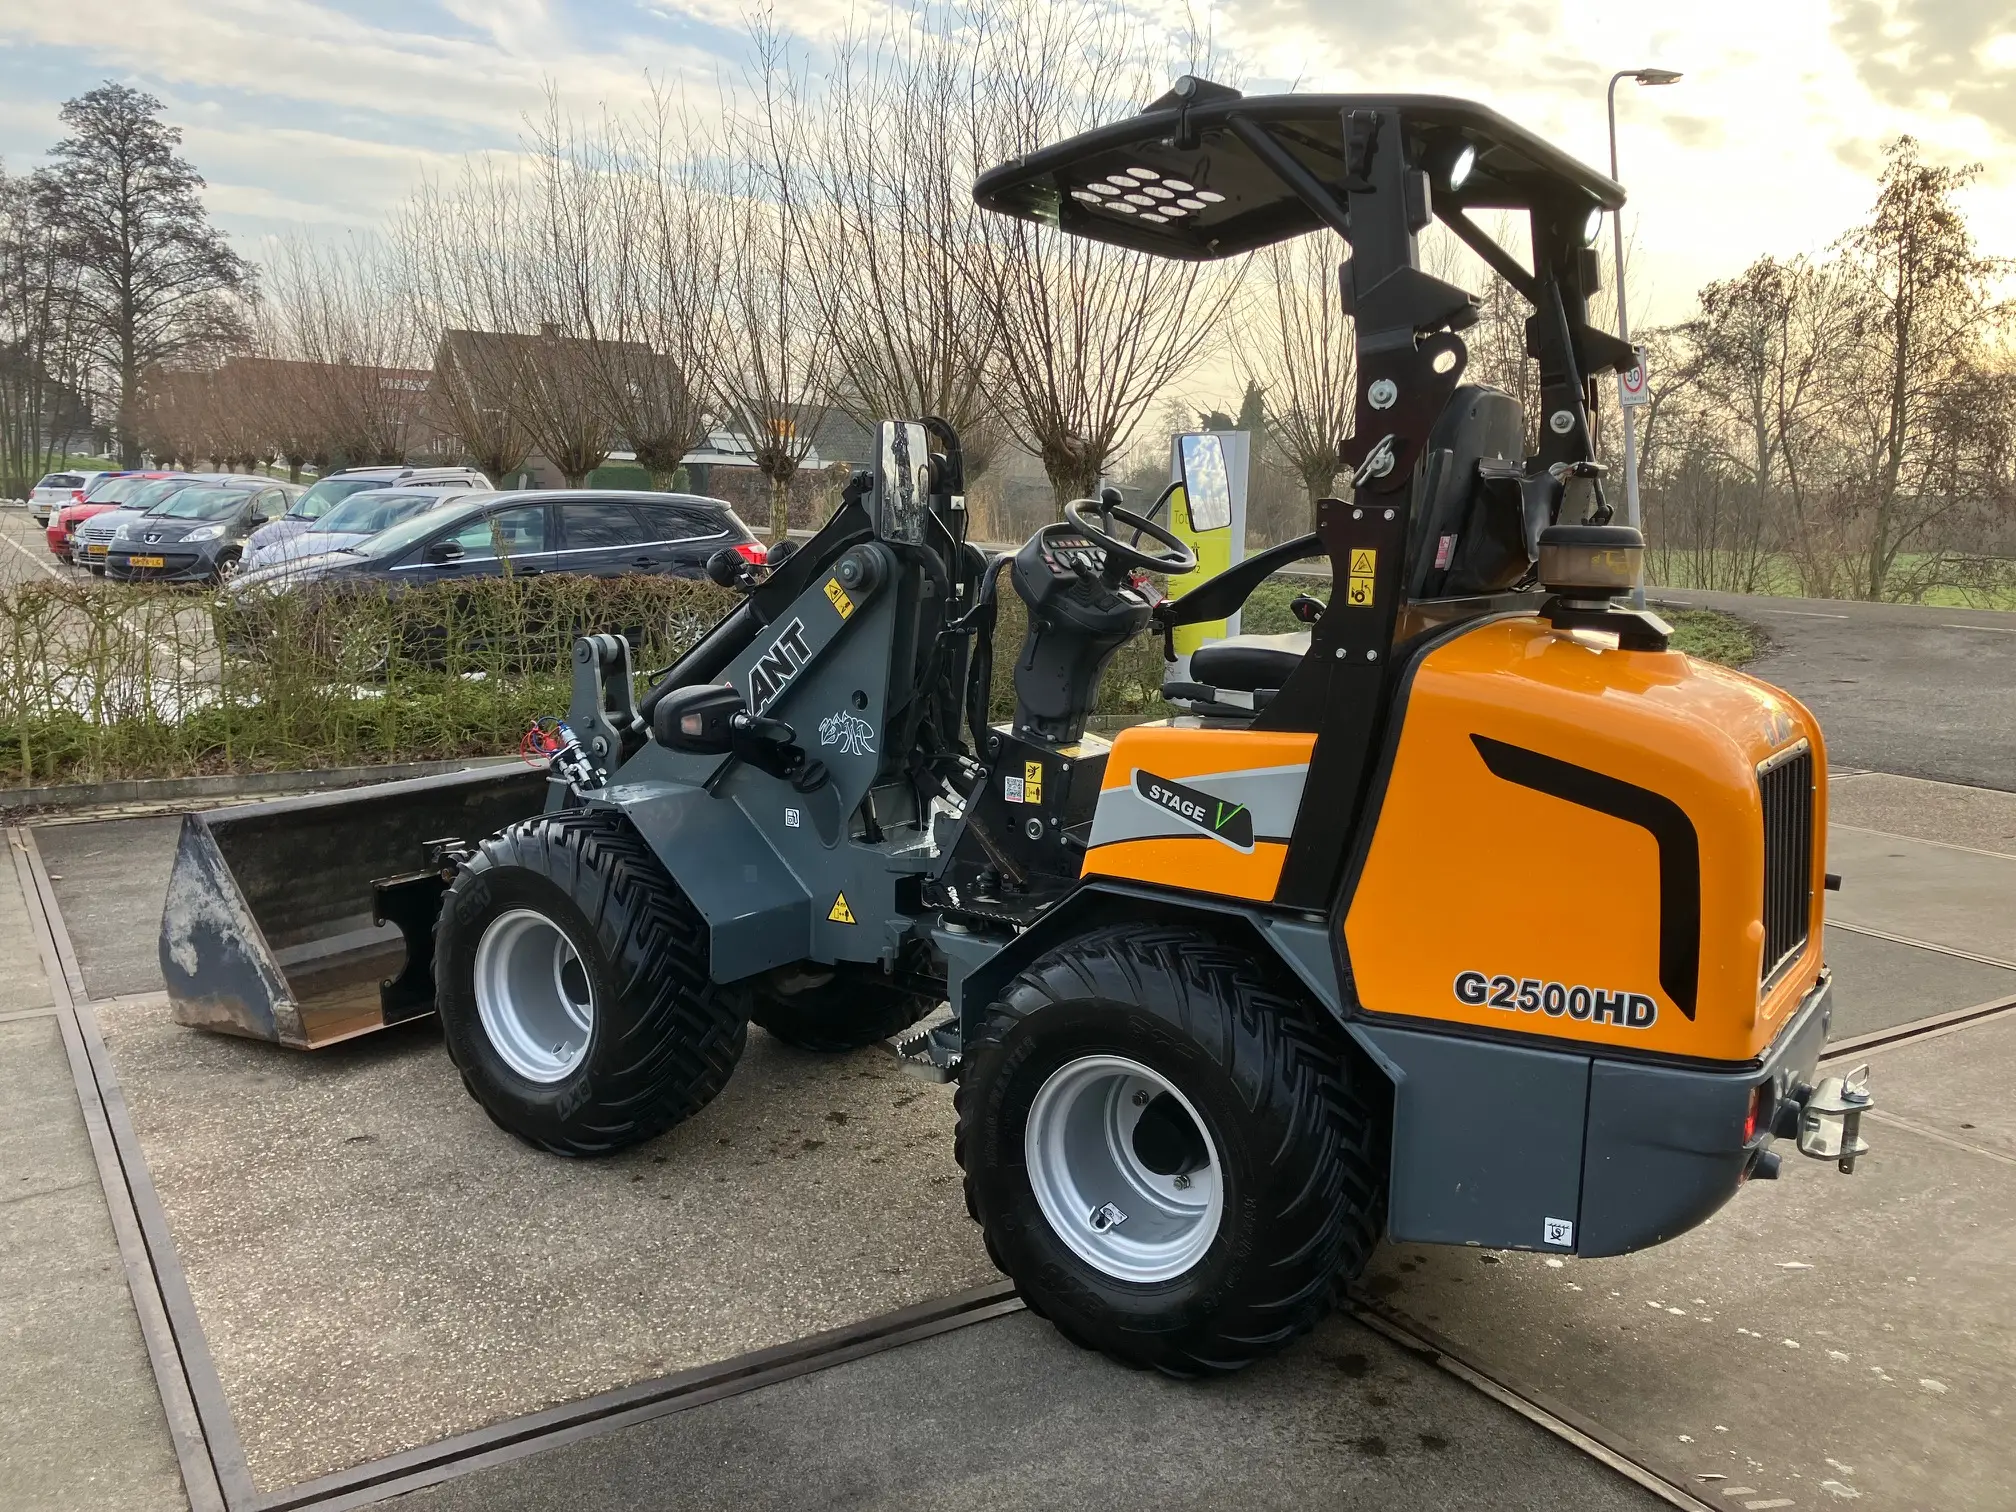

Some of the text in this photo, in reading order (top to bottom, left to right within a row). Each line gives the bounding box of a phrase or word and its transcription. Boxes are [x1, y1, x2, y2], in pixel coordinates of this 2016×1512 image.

[1626, 369, 1640, 383] 30
[747, 616, 813, 717] ANT
[1149, 784, 1245, 831] STAGE V
[1453, 969, 1659, 1029] G2500HD
